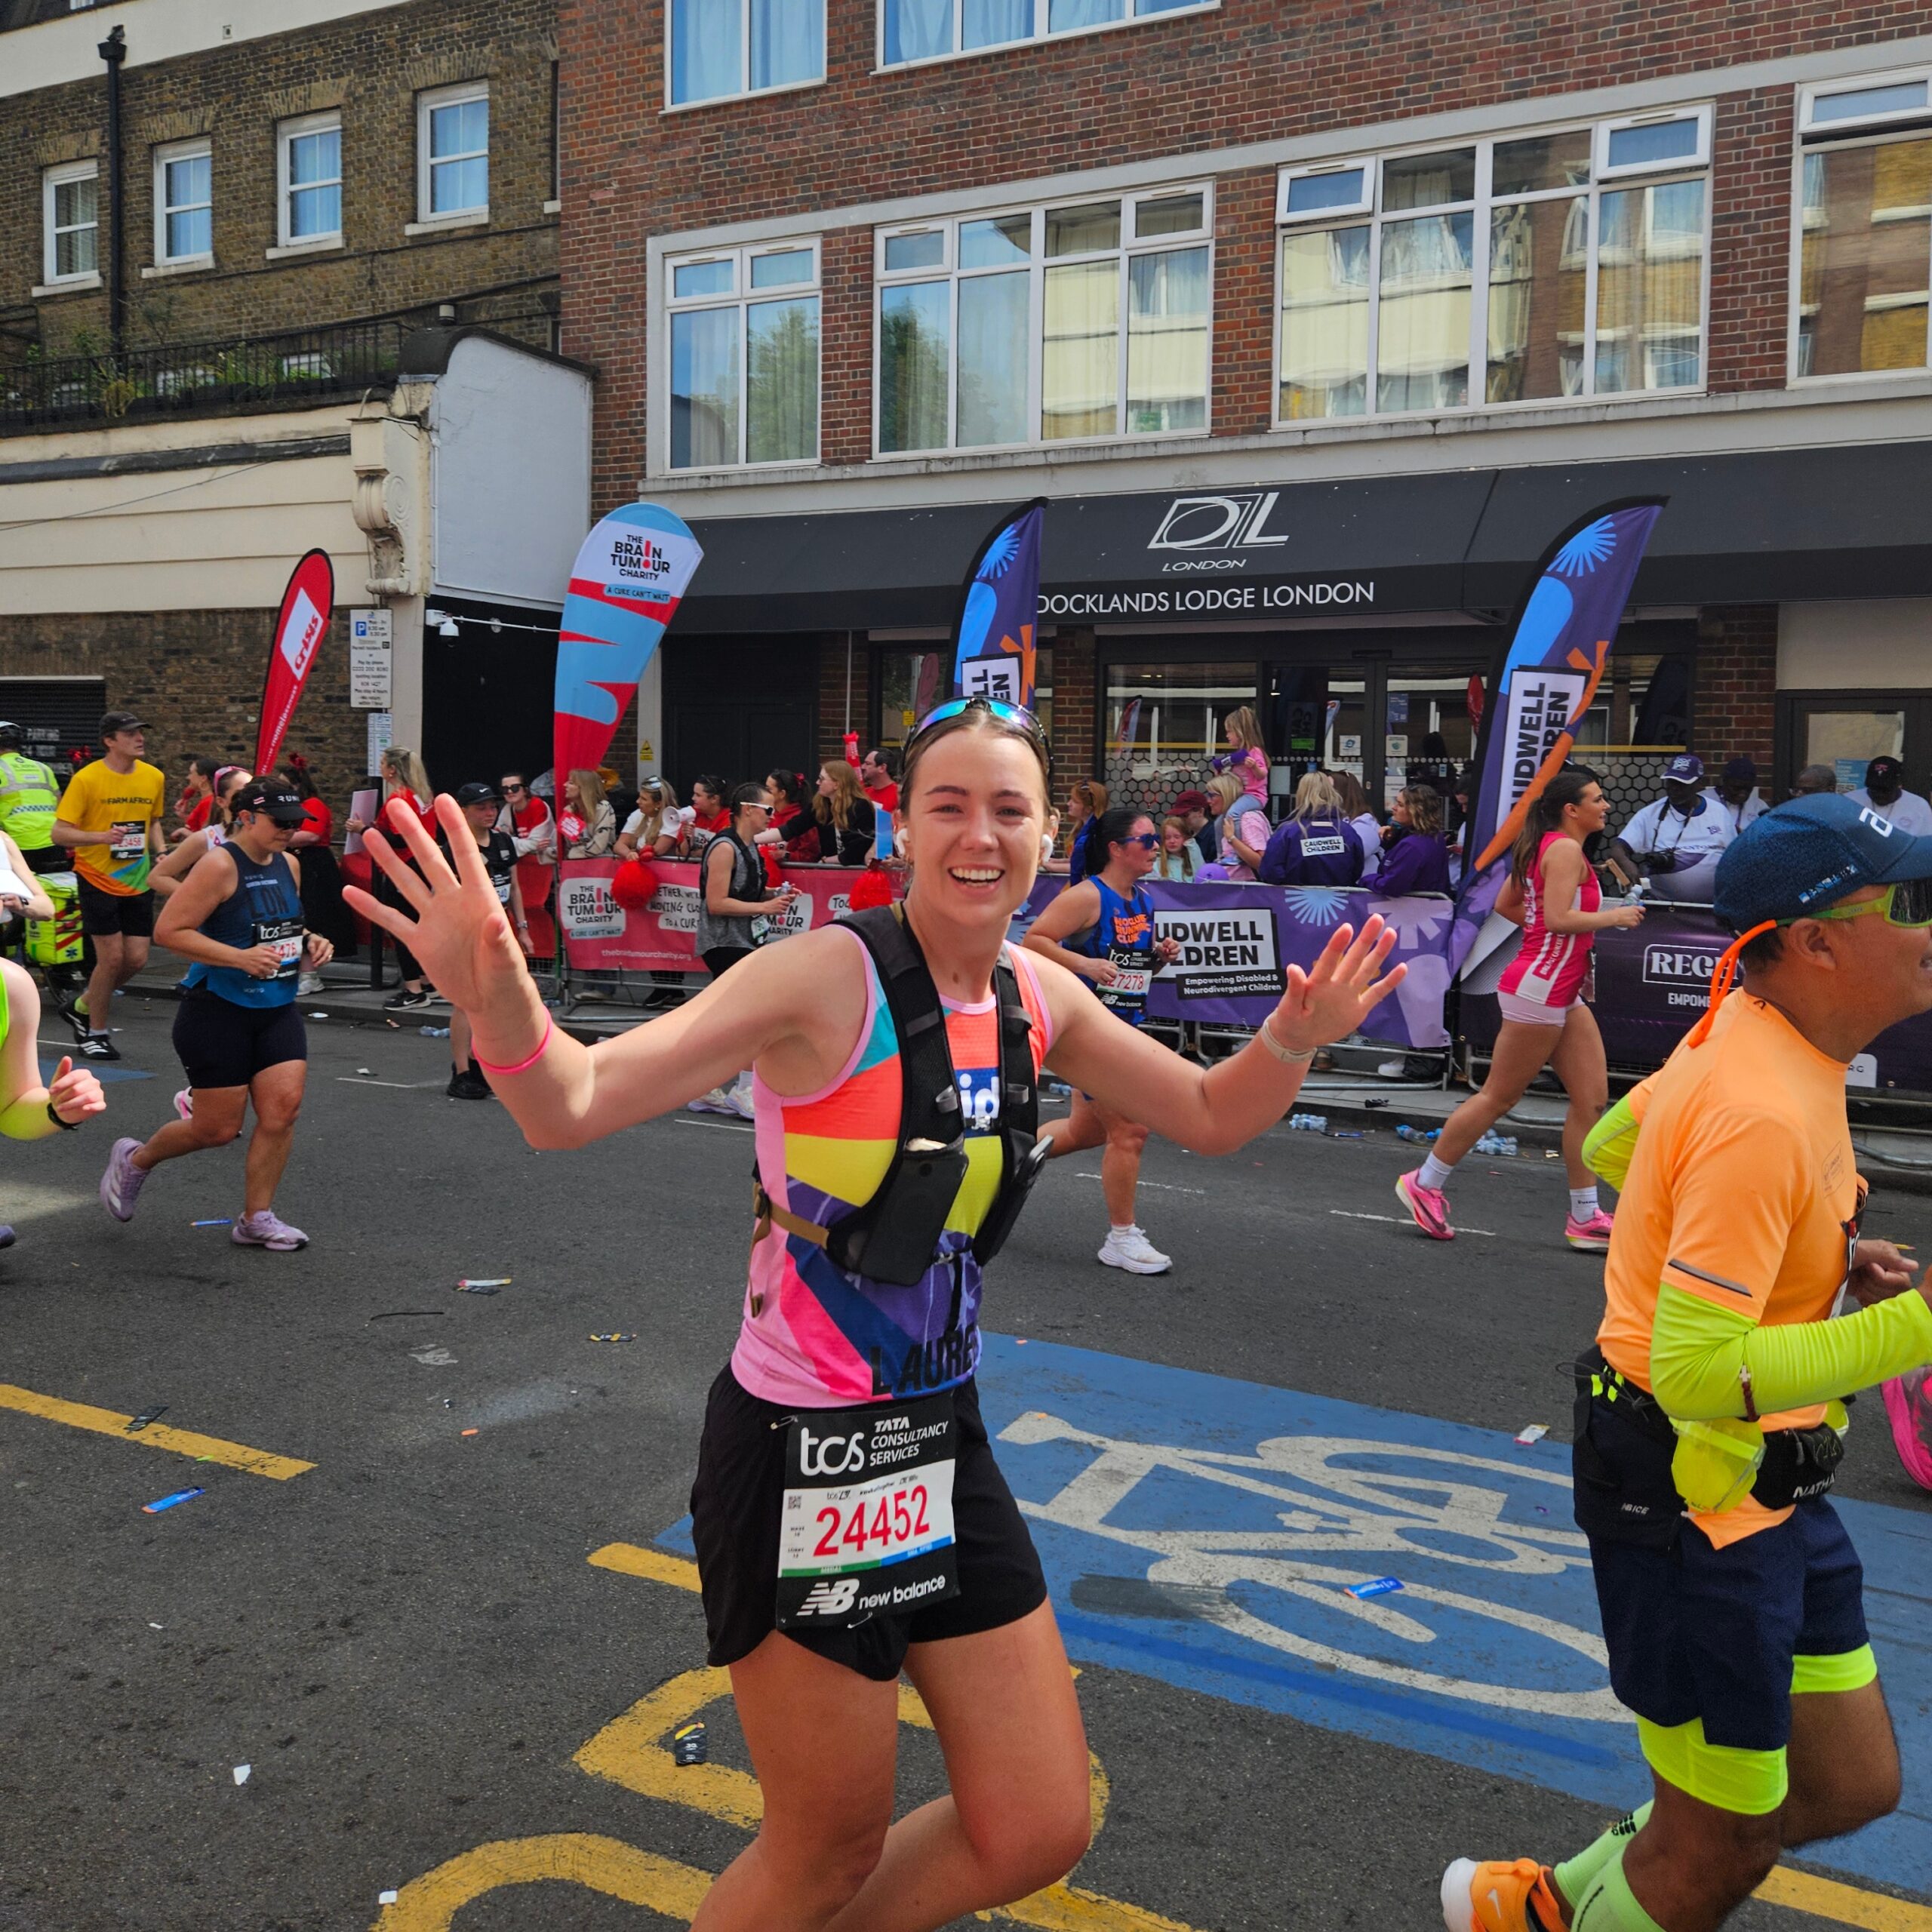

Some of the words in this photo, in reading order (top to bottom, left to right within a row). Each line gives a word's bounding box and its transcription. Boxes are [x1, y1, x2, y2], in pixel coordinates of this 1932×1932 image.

[626, 534, 643, 544] THE
[1162, 559, 1247, 571] LONDON
[620, 568, 659, 580] CHARITY
[1037, 592, 1169, 614] DOCKLANDS
[1175, 588, 1255, 611] LODGE
[1263, 582, 1374, 607] LONDON
[1511, 682, 1546, 811] UDWELL
[576, 915, 613, 924] CHARITY
[665, 918, 672, 926] TO
[260, 925, 280, 940] tcs
[1185, 976, 1235, 986] Empowering
[1236, 974, 1272, 983] Disabled
[1183, 985, 1247, 995] Neurodivergent
[1248, 983, 1281, 992] Children
[875, 1417, 910, 1432] TATA
[871, 1420, 949, 1450] CONSULTANCY
[800, 1427, 865, 1476] tcs
[869, 1444, 920, 1466] SERVICES
[813, 1484, 931, 1557] 24452
[796, 1579, 860, 1616] NB
[859, 1592, 891, 1610] new
[894, 1575, 946, 1604] balance
